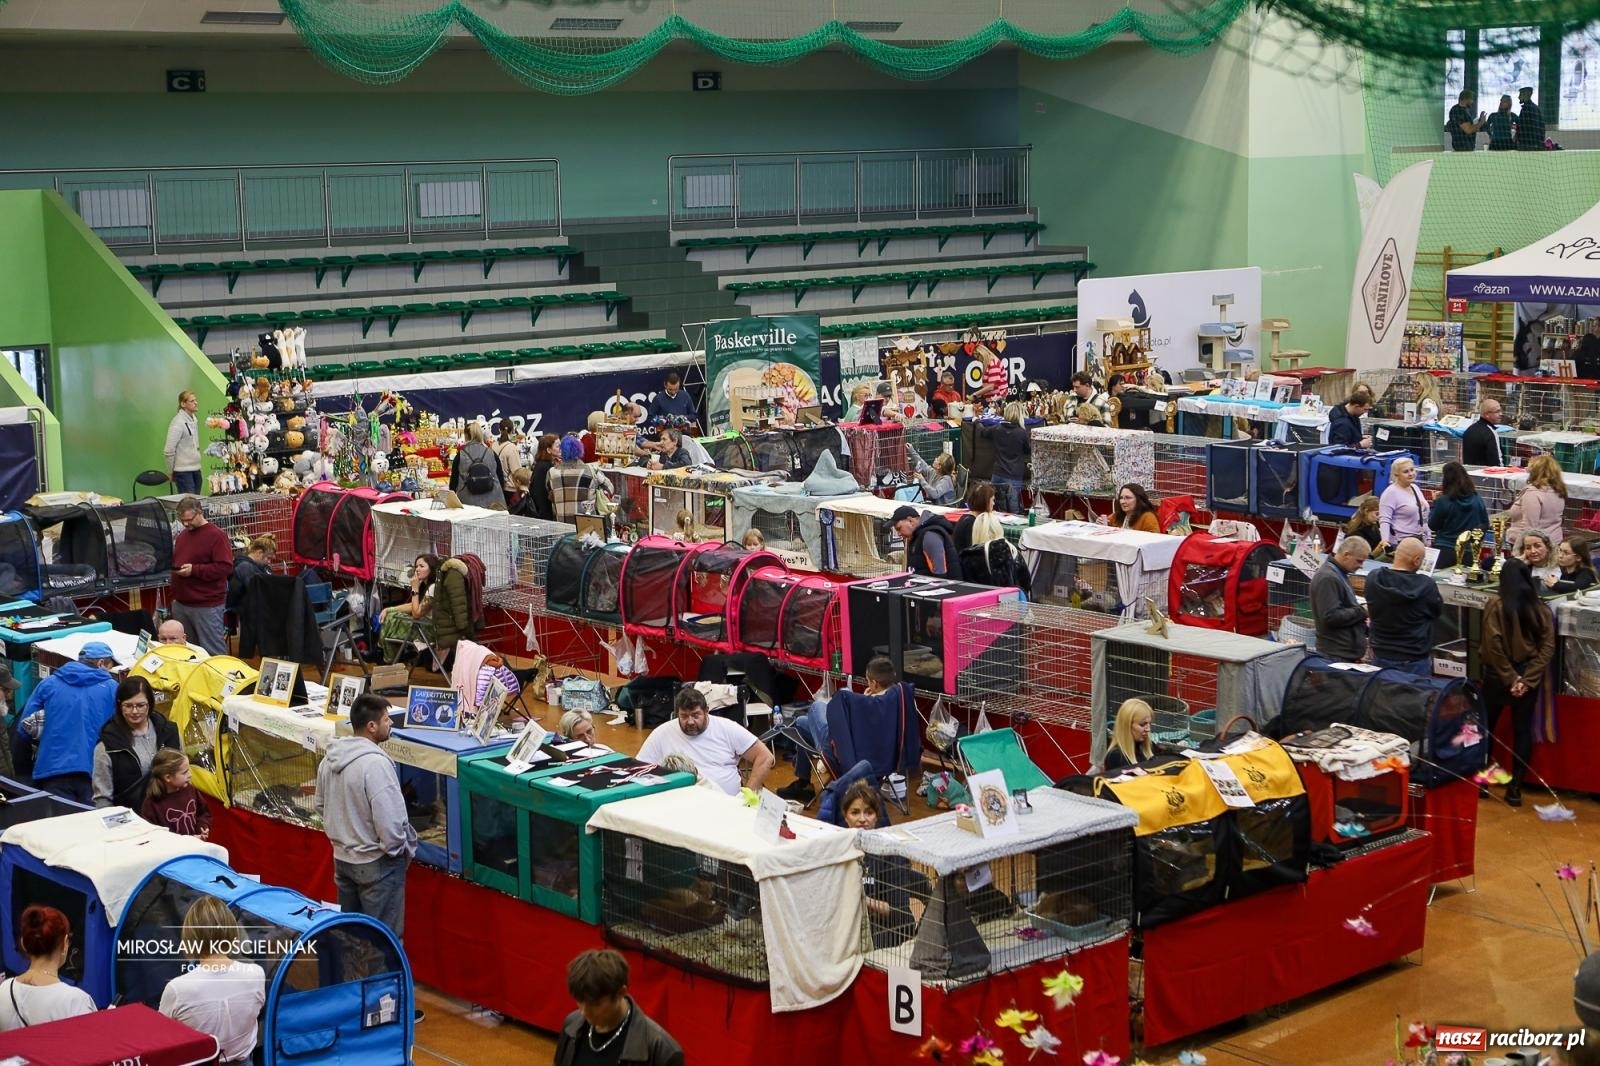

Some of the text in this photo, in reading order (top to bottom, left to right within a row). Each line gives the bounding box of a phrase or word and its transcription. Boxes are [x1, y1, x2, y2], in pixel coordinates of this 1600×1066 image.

[172, 77, 190, 90] C
[697, 78, 714, 89] D
[1374, 253, 1394, 331] CARNILOVE
[1484, 285, 1510, 295] azan
[714, 327, 797, 352] Baskerville
[895, 984, 915, 1025] B
